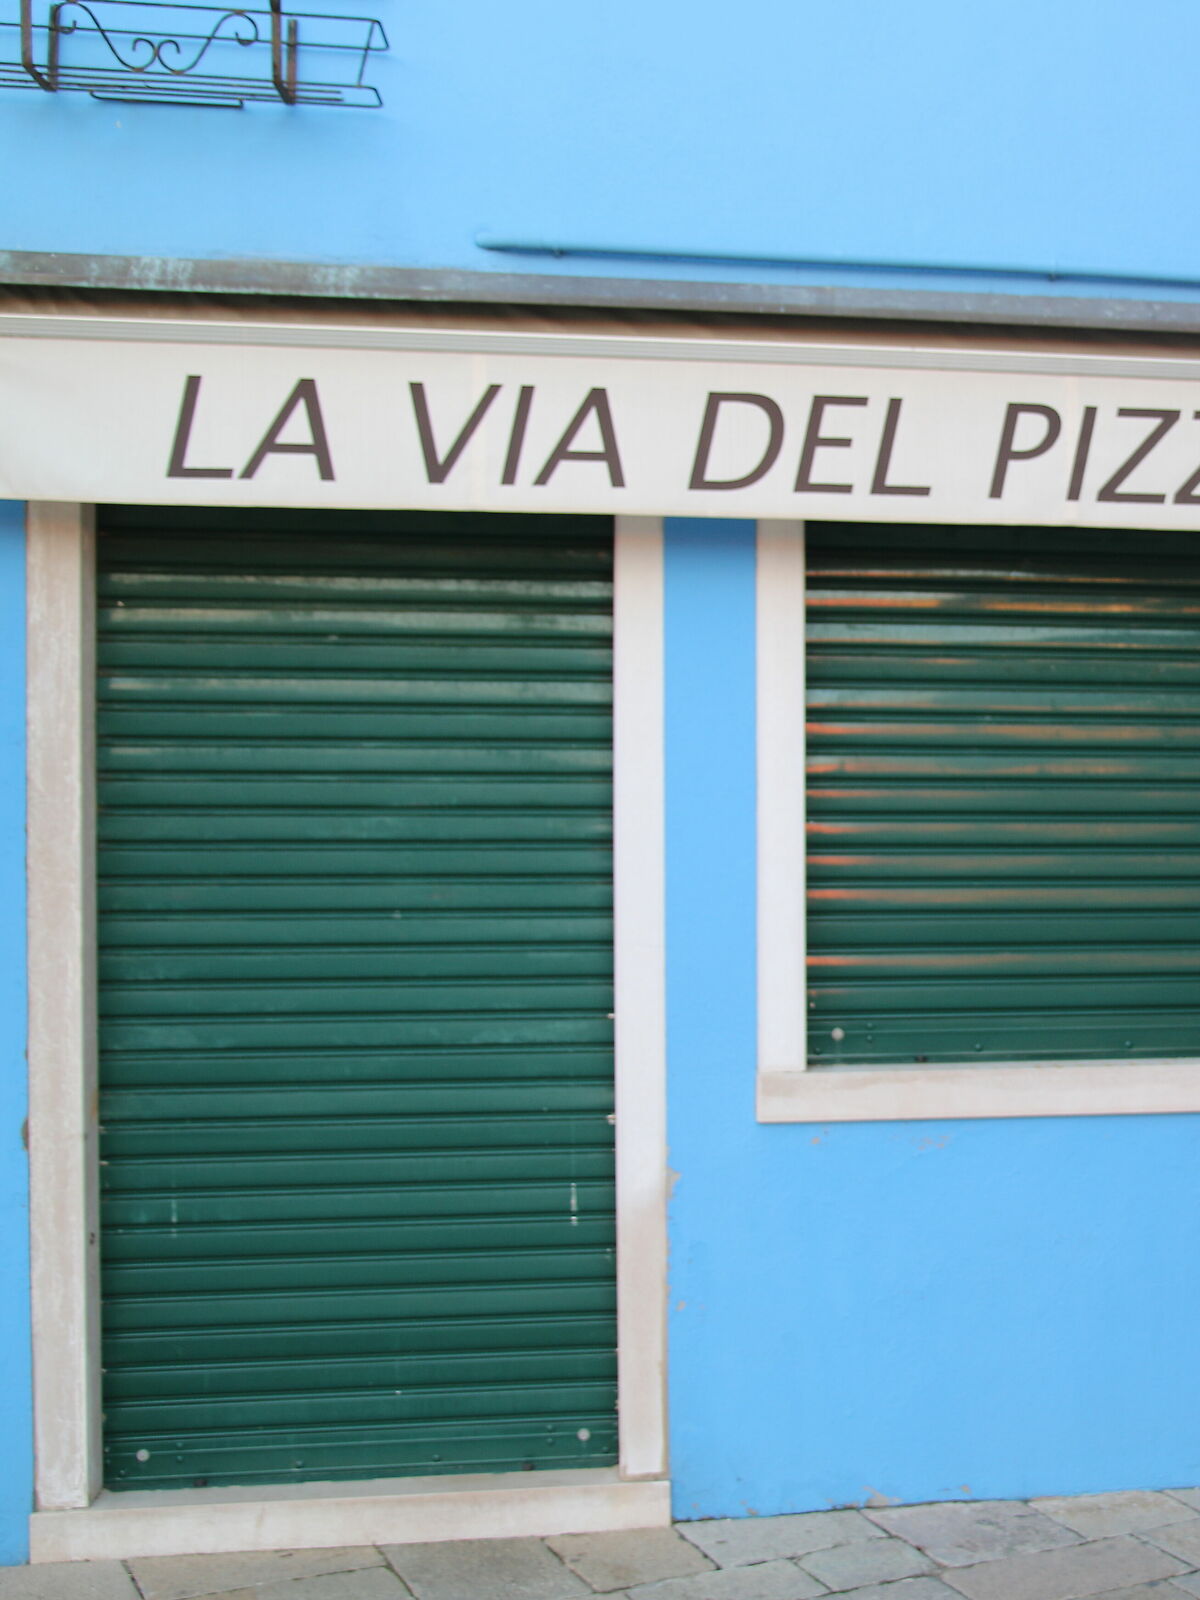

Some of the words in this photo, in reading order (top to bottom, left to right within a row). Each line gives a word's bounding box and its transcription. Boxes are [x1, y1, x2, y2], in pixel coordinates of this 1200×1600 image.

[166, 375, 336, 481] LA
[408, 381, 627, 488] VIA
[688, 391, 932, 496] DEL
